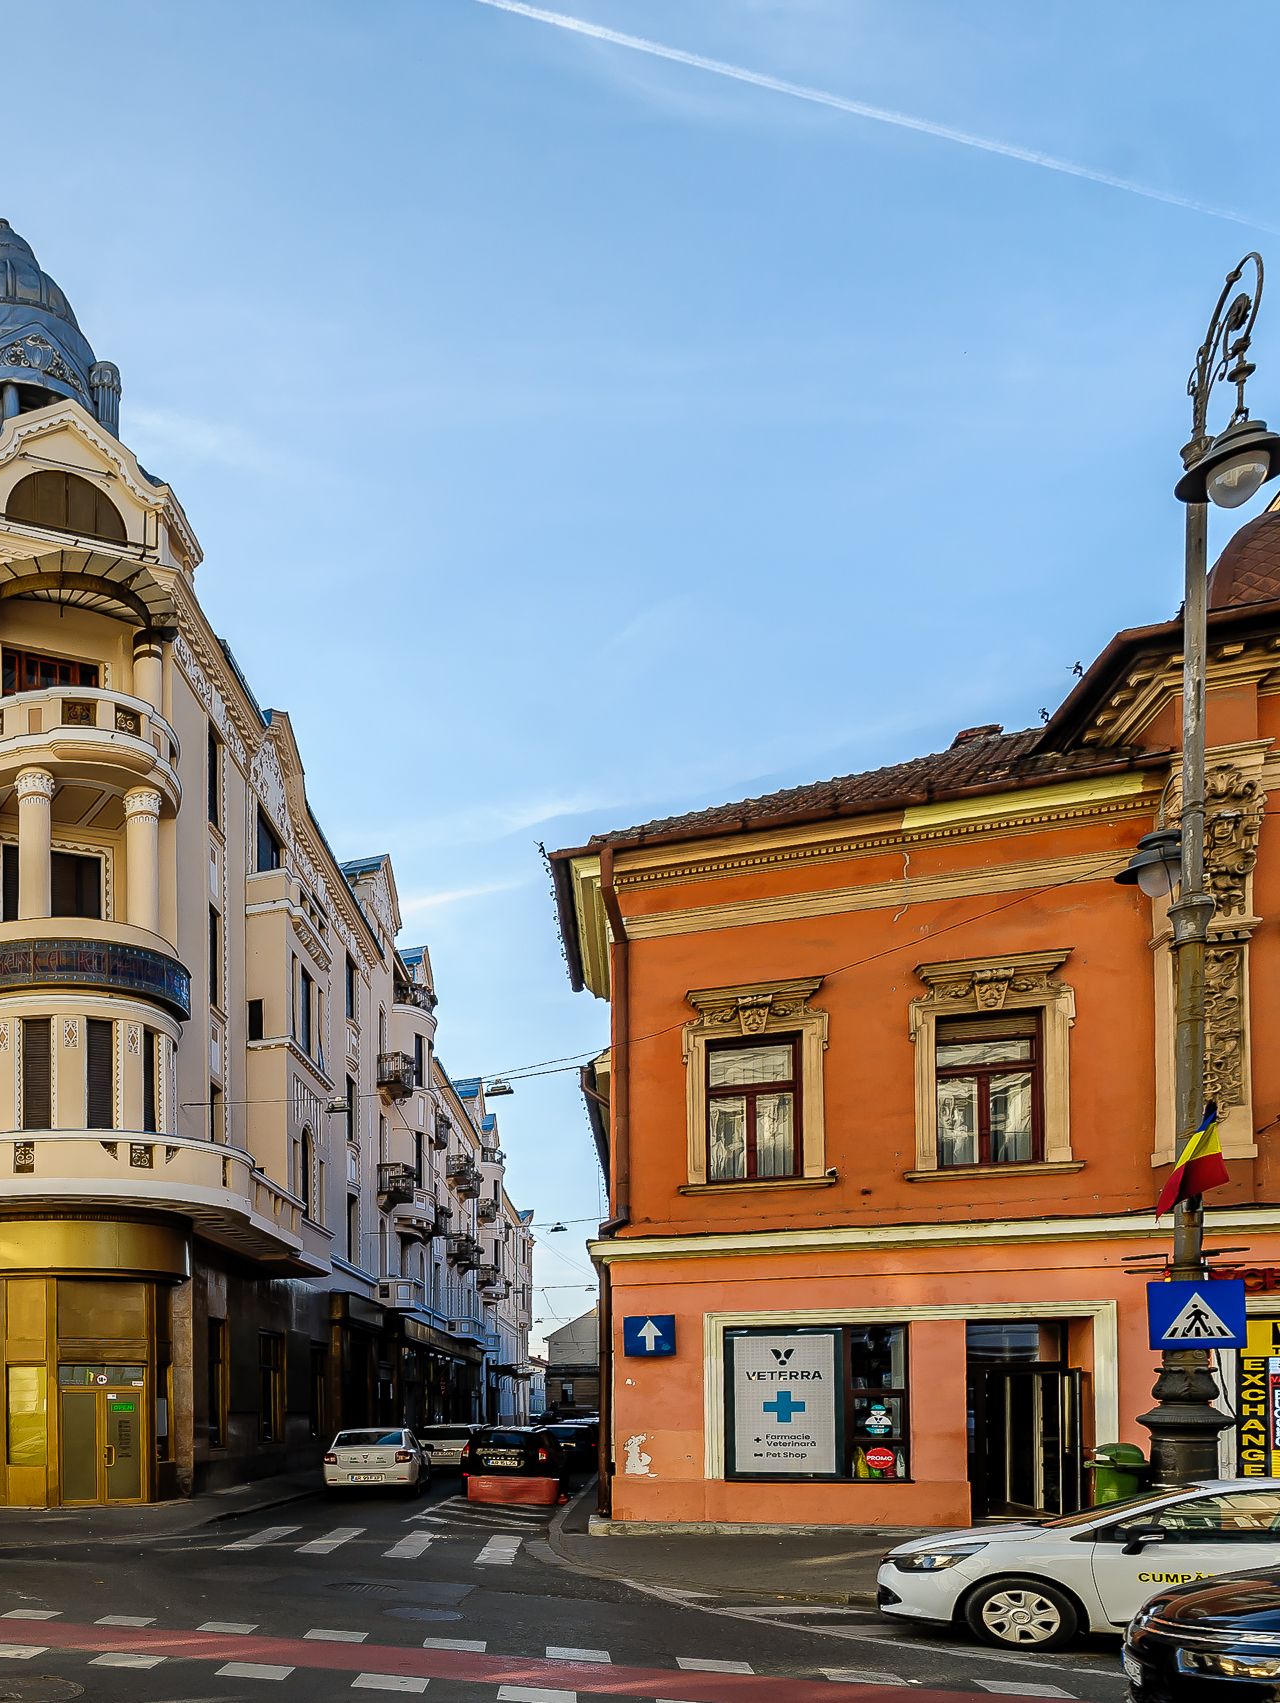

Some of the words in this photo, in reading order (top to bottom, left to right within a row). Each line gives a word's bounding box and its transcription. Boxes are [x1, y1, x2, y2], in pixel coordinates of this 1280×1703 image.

[746, 1370, 823, 1381] VETERRA
[1241, 1358, 1266, 1476] EXCHANGE
[765, 1433, 811, 1441] Farmacie
[766, 1440, 817, 1448] Veterinară
[765, 1451, 782, 1459] Pet
[782, 1451, 807, 1460] Shop
[1138, 1572, 1215, 1584] CUMPĂ
